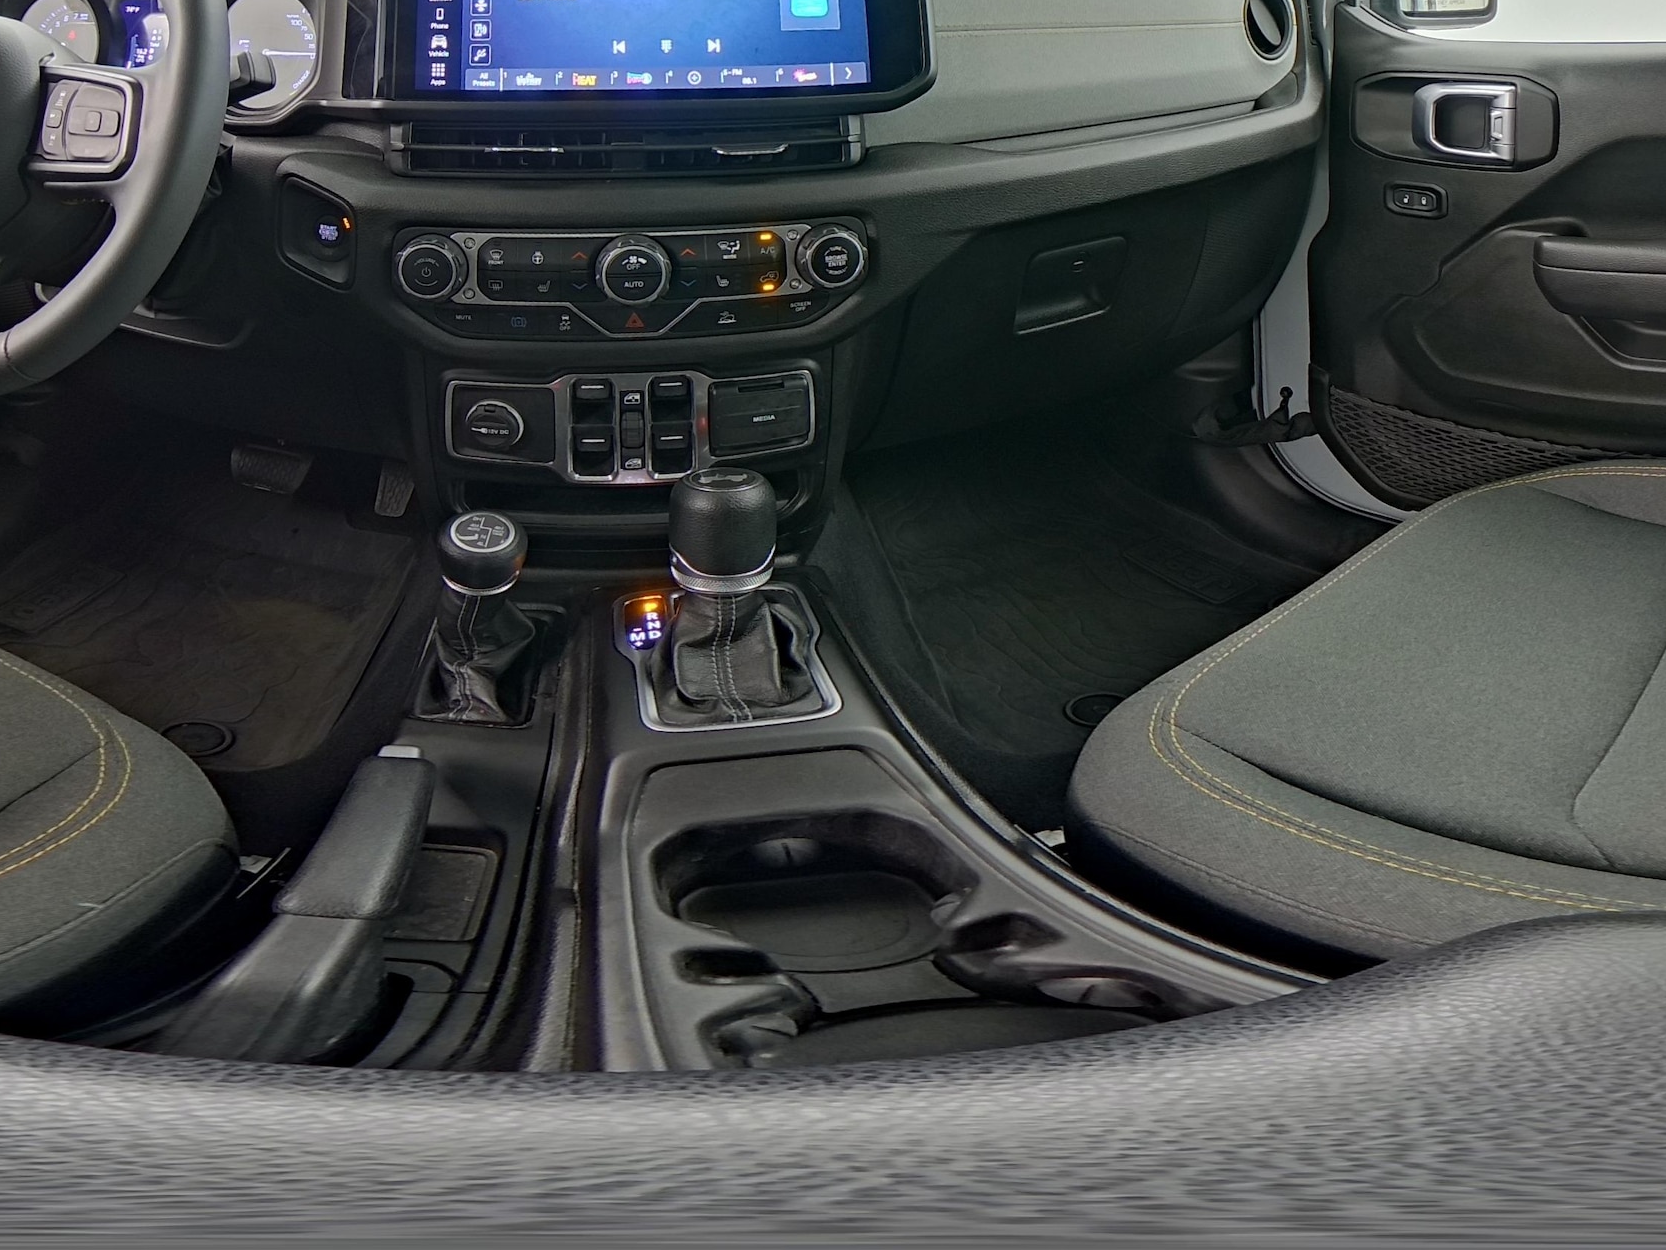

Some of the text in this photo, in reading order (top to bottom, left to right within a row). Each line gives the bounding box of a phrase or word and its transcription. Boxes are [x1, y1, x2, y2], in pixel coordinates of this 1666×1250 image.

[290, 19, 303, 27] 100
[430, 22, 449, 30] Phone
[304, 33, 314, 41] 50
[428, 50, 449, 58] Vehicle
[430, 78, 446, 86] Apps
[472, 79, 496, 87] Presets
[760, 246, 775, 255] A/C
[824, 254, 848, 262] BROWSE
[790, 300, 812, 309] SCREEN
[752, 414, 776, 423] MEDIA
[644, 602, 658, 612] P
[646, 611, 659, 620] R
[647, 620, 661, 630] N
[629, 631, 646, 641] M
[648, 630, 662, 639] D
